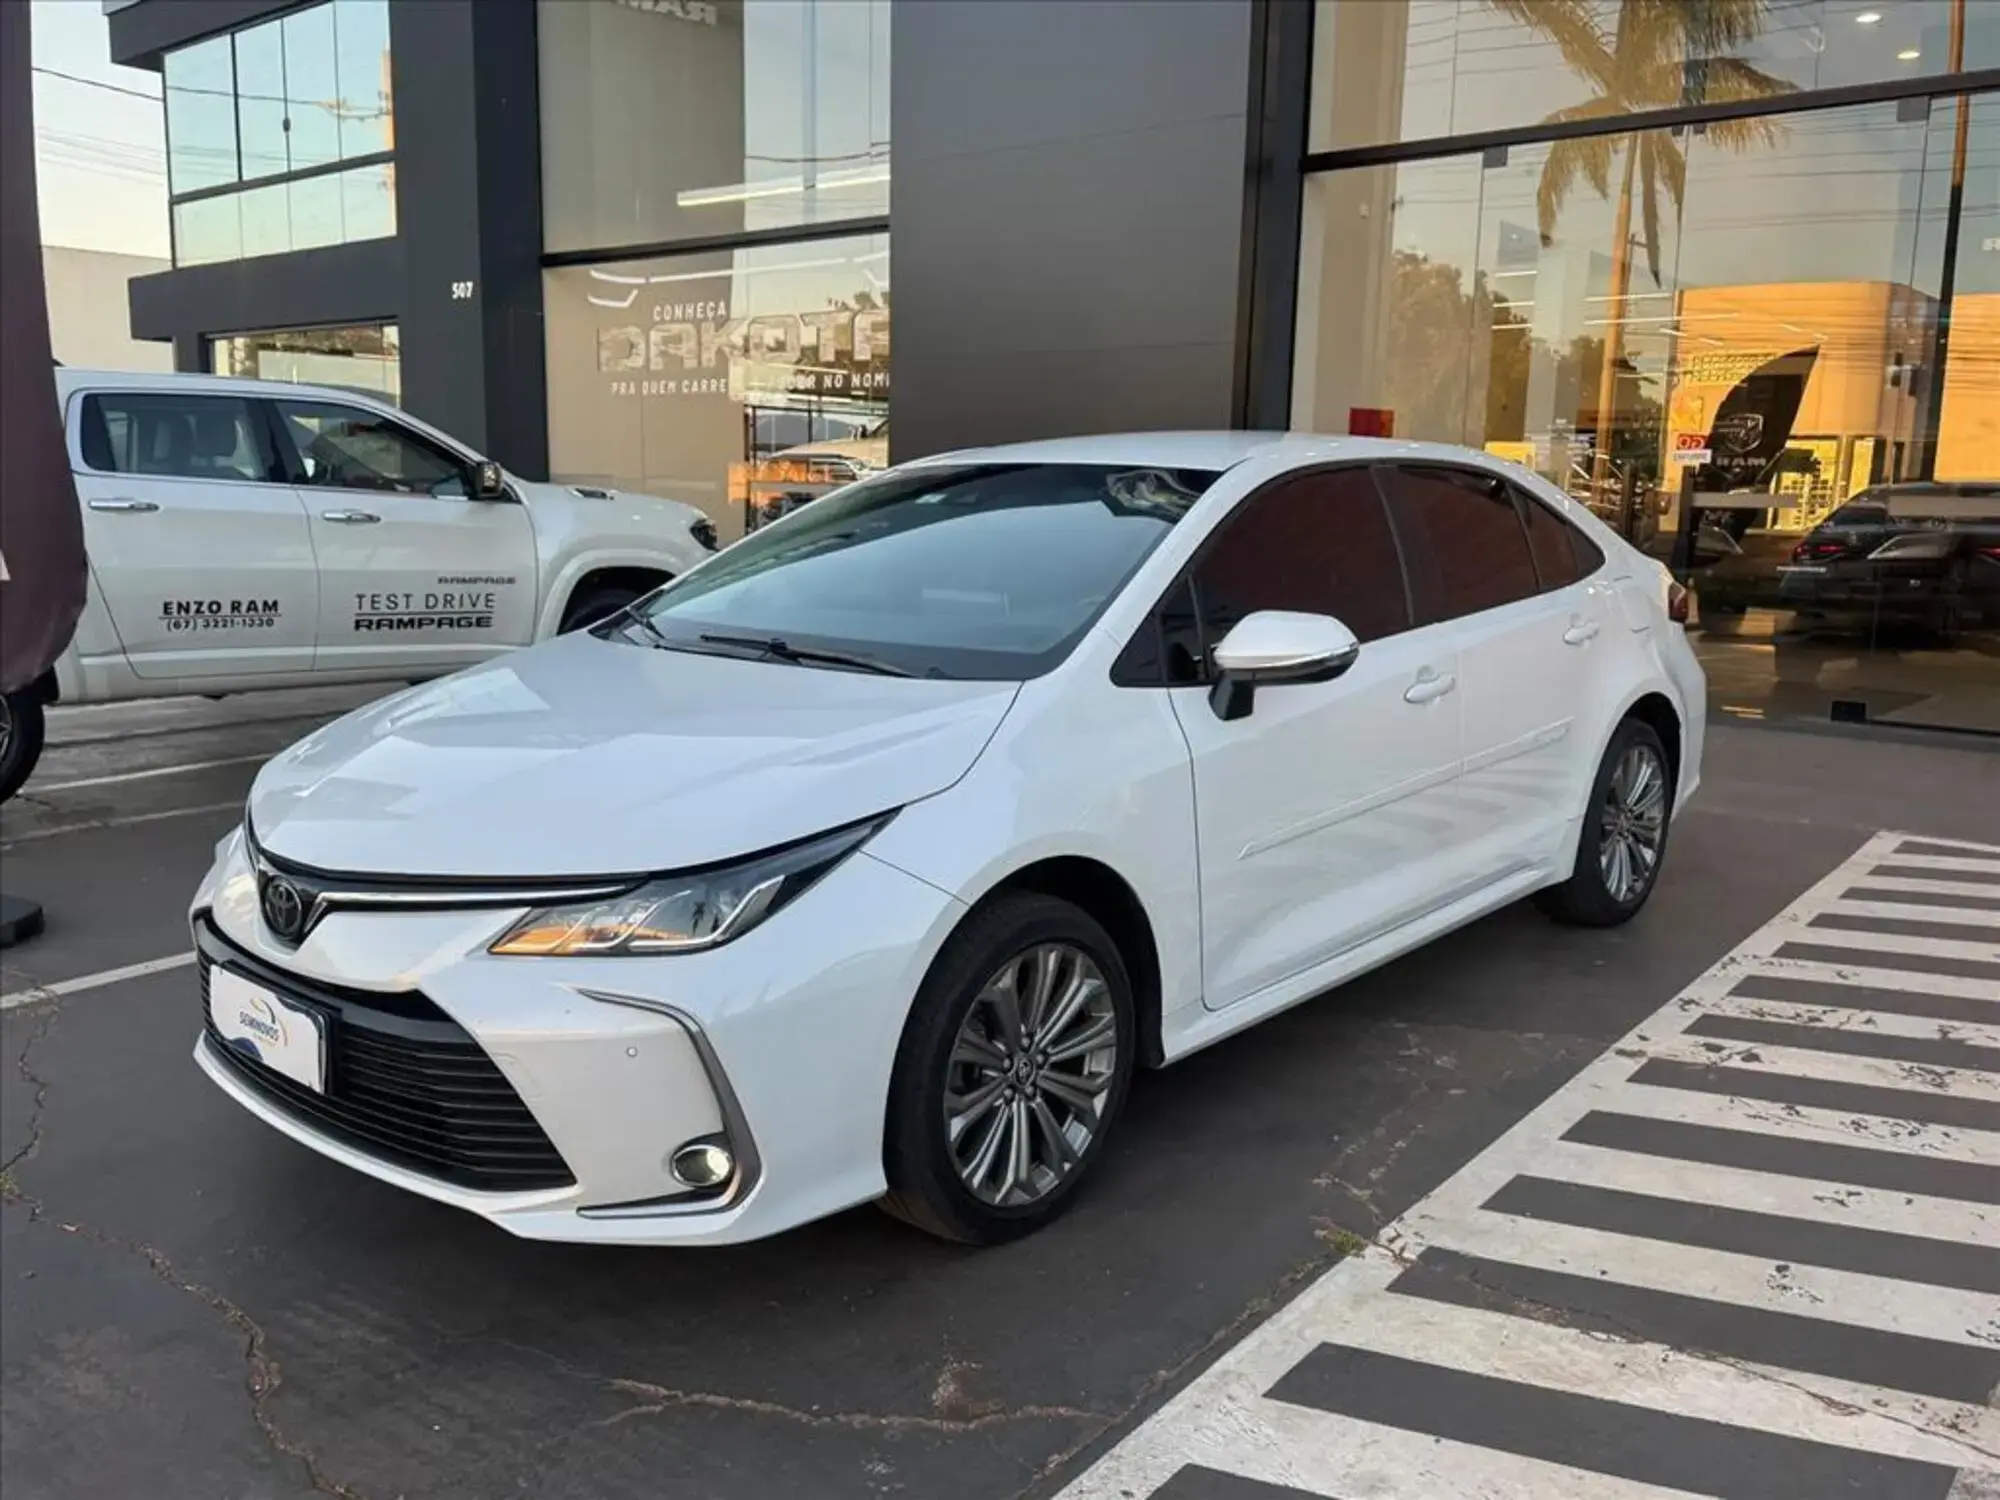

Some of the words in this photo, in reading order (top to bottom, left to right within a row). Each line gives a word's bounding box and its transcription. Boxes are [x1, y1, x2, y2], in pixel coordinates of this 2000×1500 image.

[452, 282, 473, 299] 507
[653, 301, 726, 321] CONHEÇA
[611, 381, 636, 396] PRA
[642, 379, 677, 395] QUEM
[823, 374, 843, 389] NO
[437, 576, 516, 585] RAMPAGE
[163, 600, 222, 615] ENZO
[230, 599, 279, 614] RAM
[355, 593, 413, 611] TEST
[425, 592, 496, 609] DRIVE
[167, 619, 198, 632] (67)
[354, 616, 493, 631] RAMPAGE
